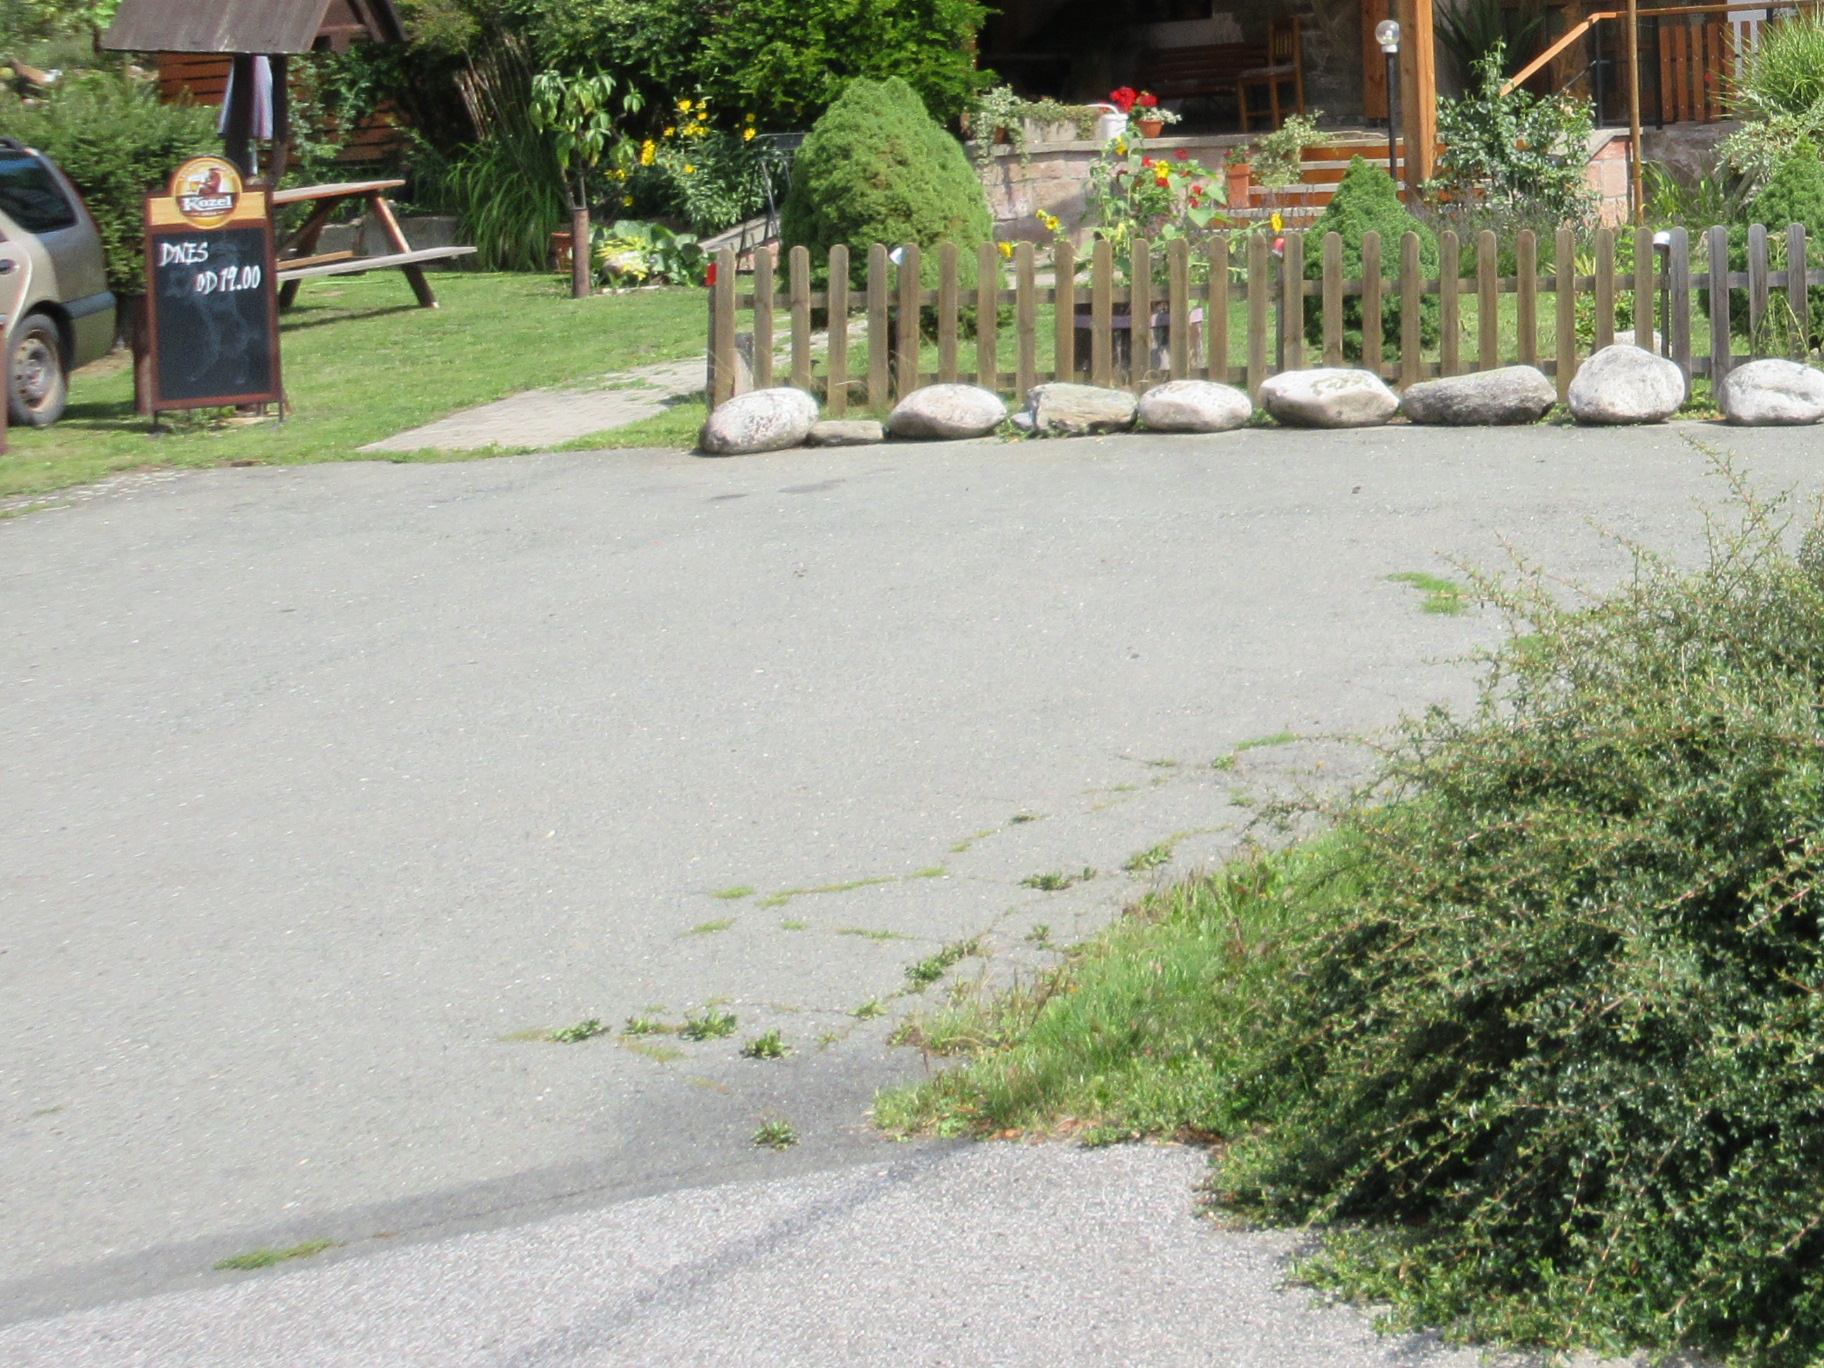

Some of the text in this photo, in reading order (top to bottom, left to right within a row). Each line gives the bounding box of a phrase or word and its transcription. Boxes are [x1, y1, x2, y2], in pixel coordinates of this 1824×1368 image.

[181, 194, 233, 212] Kozel
[158, 241, 209, 267] DNES
[195, 270, 218, 295] OD
